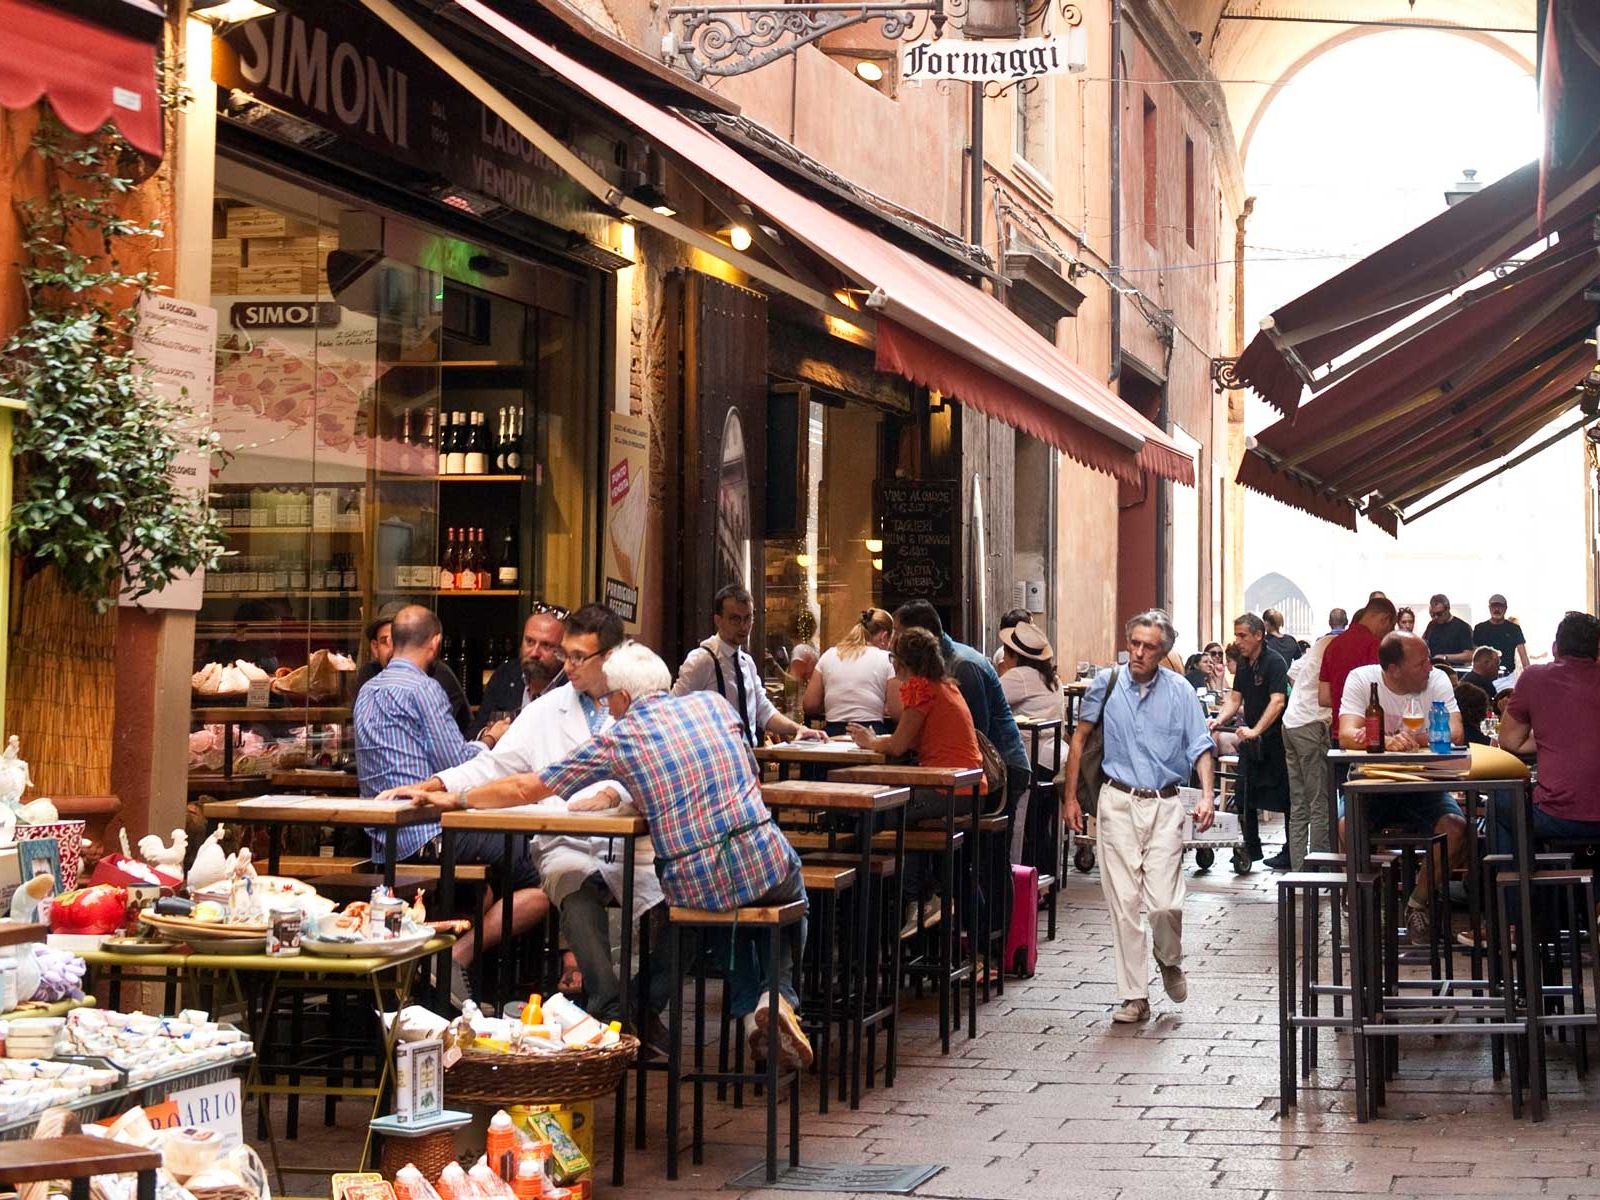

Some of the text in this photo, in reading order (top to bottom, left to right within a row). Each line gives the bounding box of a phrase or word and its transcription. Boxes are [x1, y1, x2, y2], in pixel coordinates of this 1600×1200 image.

[239, 14, 408, 149] SIMONI
[903, 37, 1059, 78] Formaggi
[472, 153, 537, 210] VENDITA
[893, 519, 934, 533] TAGLIERI
